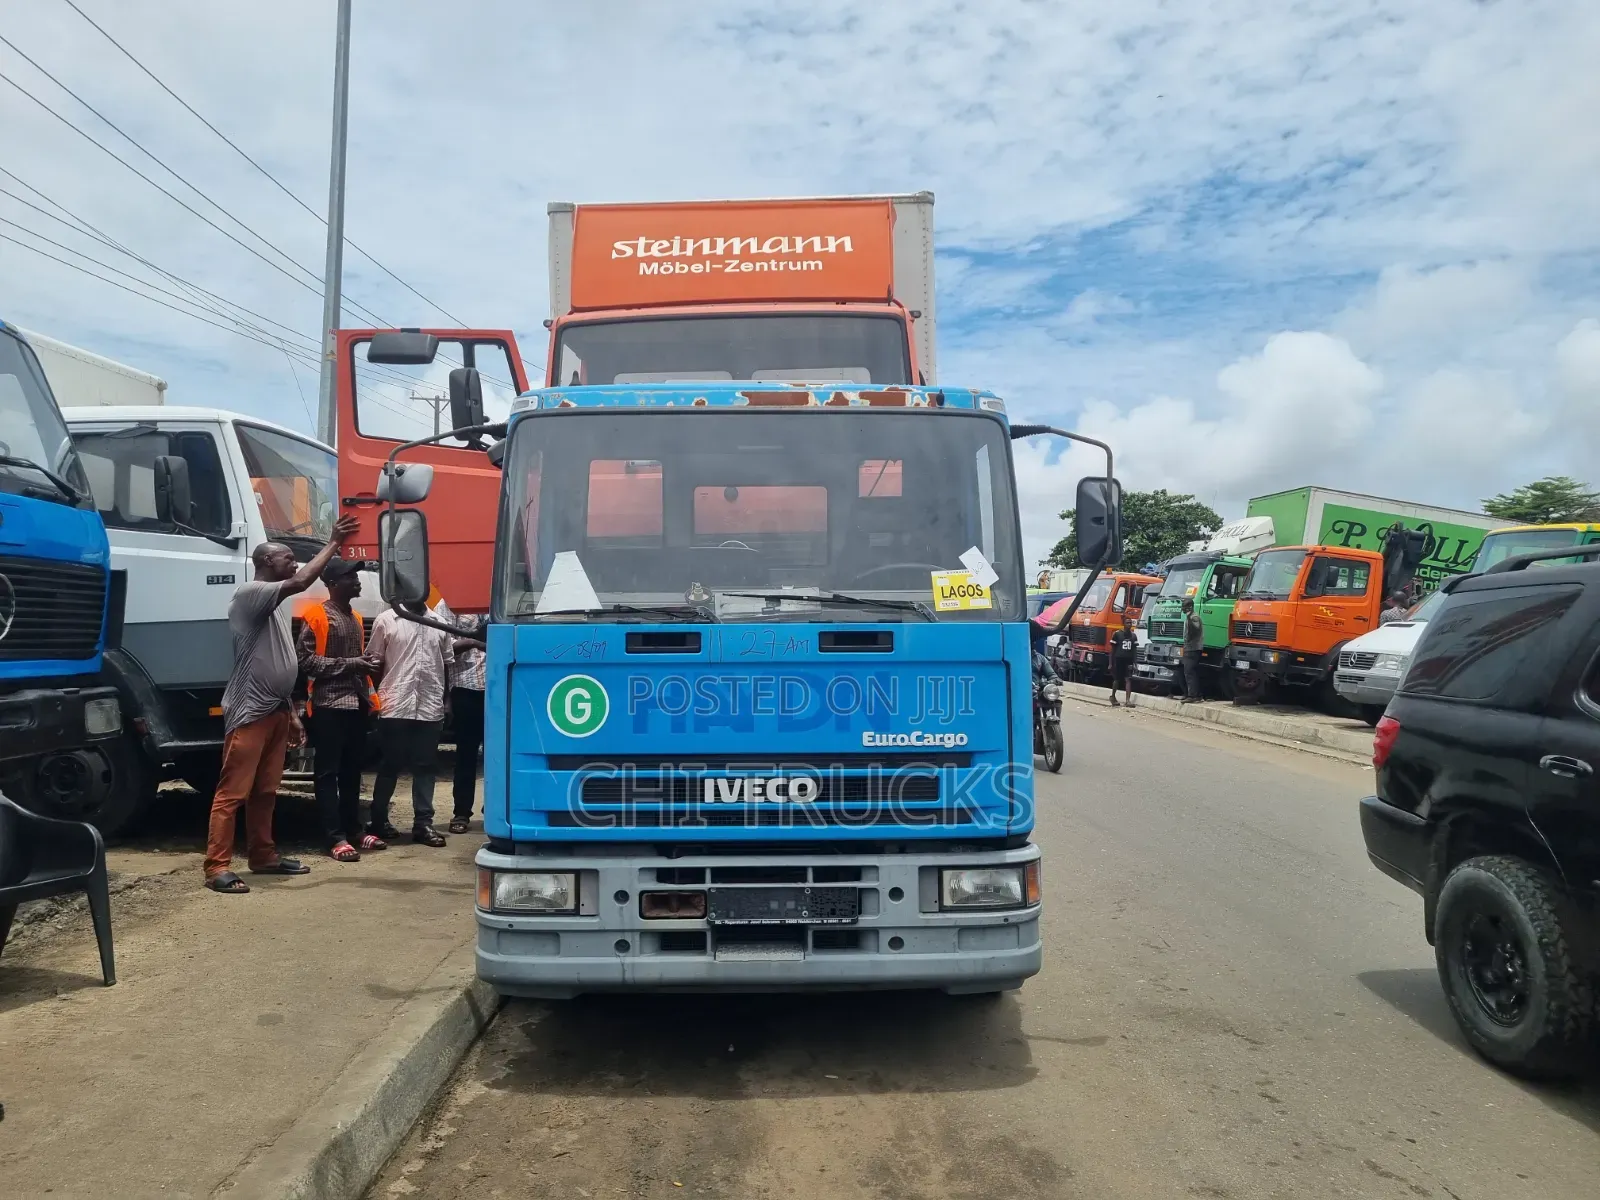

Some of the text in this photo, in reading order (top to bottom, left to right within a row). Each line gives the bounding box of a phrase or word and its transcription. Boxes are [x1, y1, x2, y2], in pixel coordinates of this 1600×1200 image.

[611, 235, 853, 260] steinmann
[638, 258, 823, 276] Möbel-Zentrum
[208, 575, 233, 584] 914
[941, 583, 984, 599] LAGOS
[1121, 640, 1132, 650] 20
[564, 687, 592, 725] G
[862, 731, 969, 749] EuroCargo
[703, 777, 819, 804] IVECO
